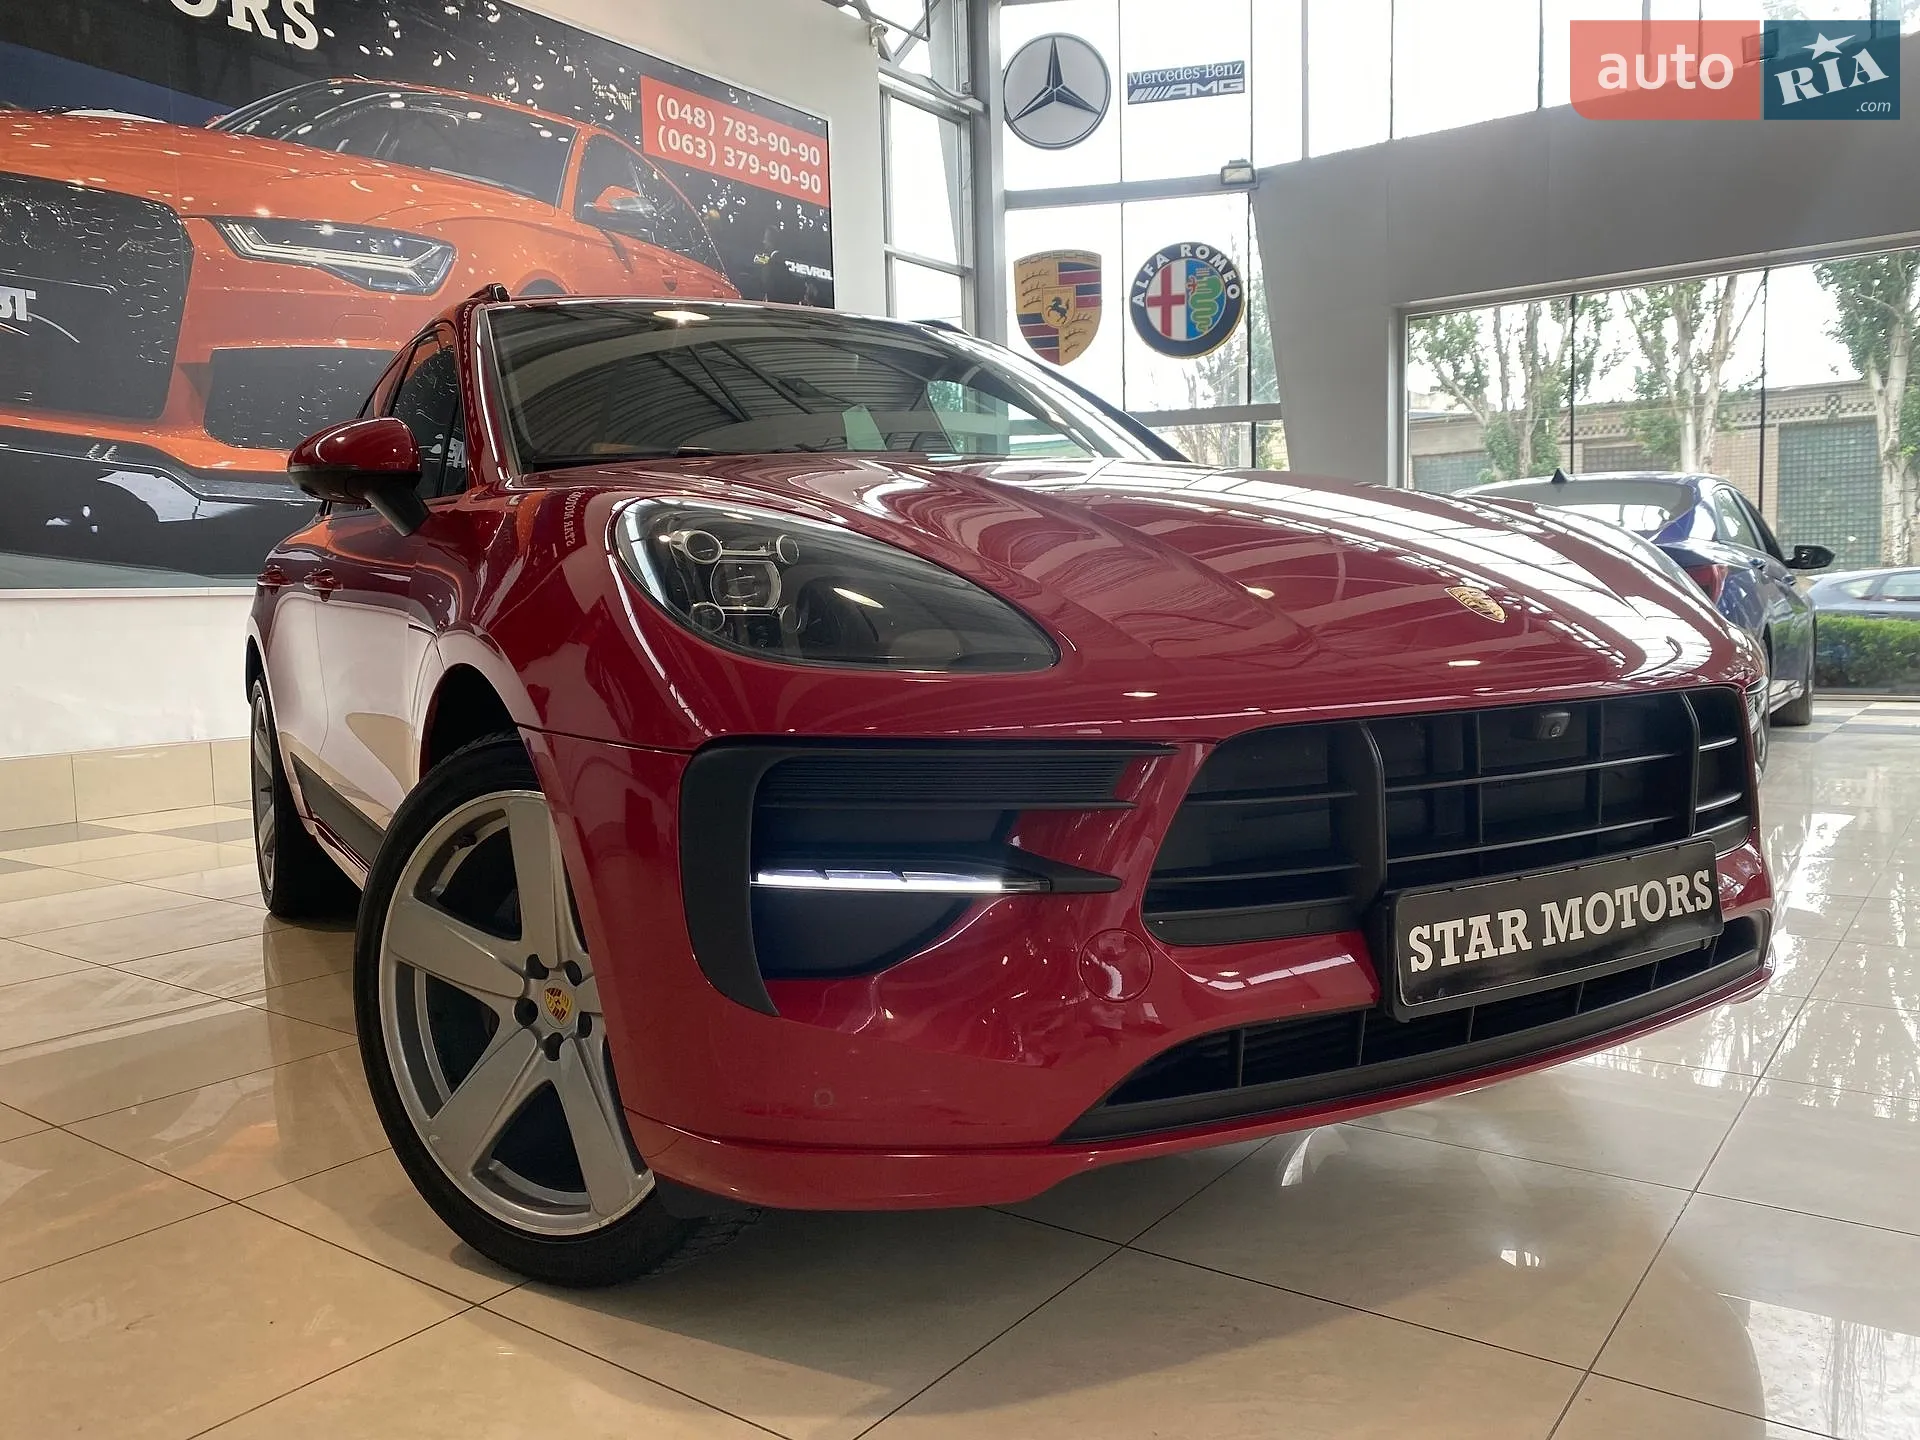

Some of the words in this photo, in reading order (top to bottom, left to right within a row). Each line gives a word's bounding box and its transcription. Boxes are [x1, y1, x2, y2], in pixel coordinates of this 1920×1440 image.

[1128, 62, 1243, 86] Mercedes-Benz
[656, 94, 716, 136] (048)
[723, 116, 820, 166] 783-90-90
[657, 125, 717, 167] (063)
[723, 146, 821, 194] 379-90-90
[1132, 253, 1170, 307] ALFA
[1180, 244, 1241, 299] ROMEO
[1408, 908, 1532, 973] STAR
[1541, 869, 1713, 947] MOTORS
